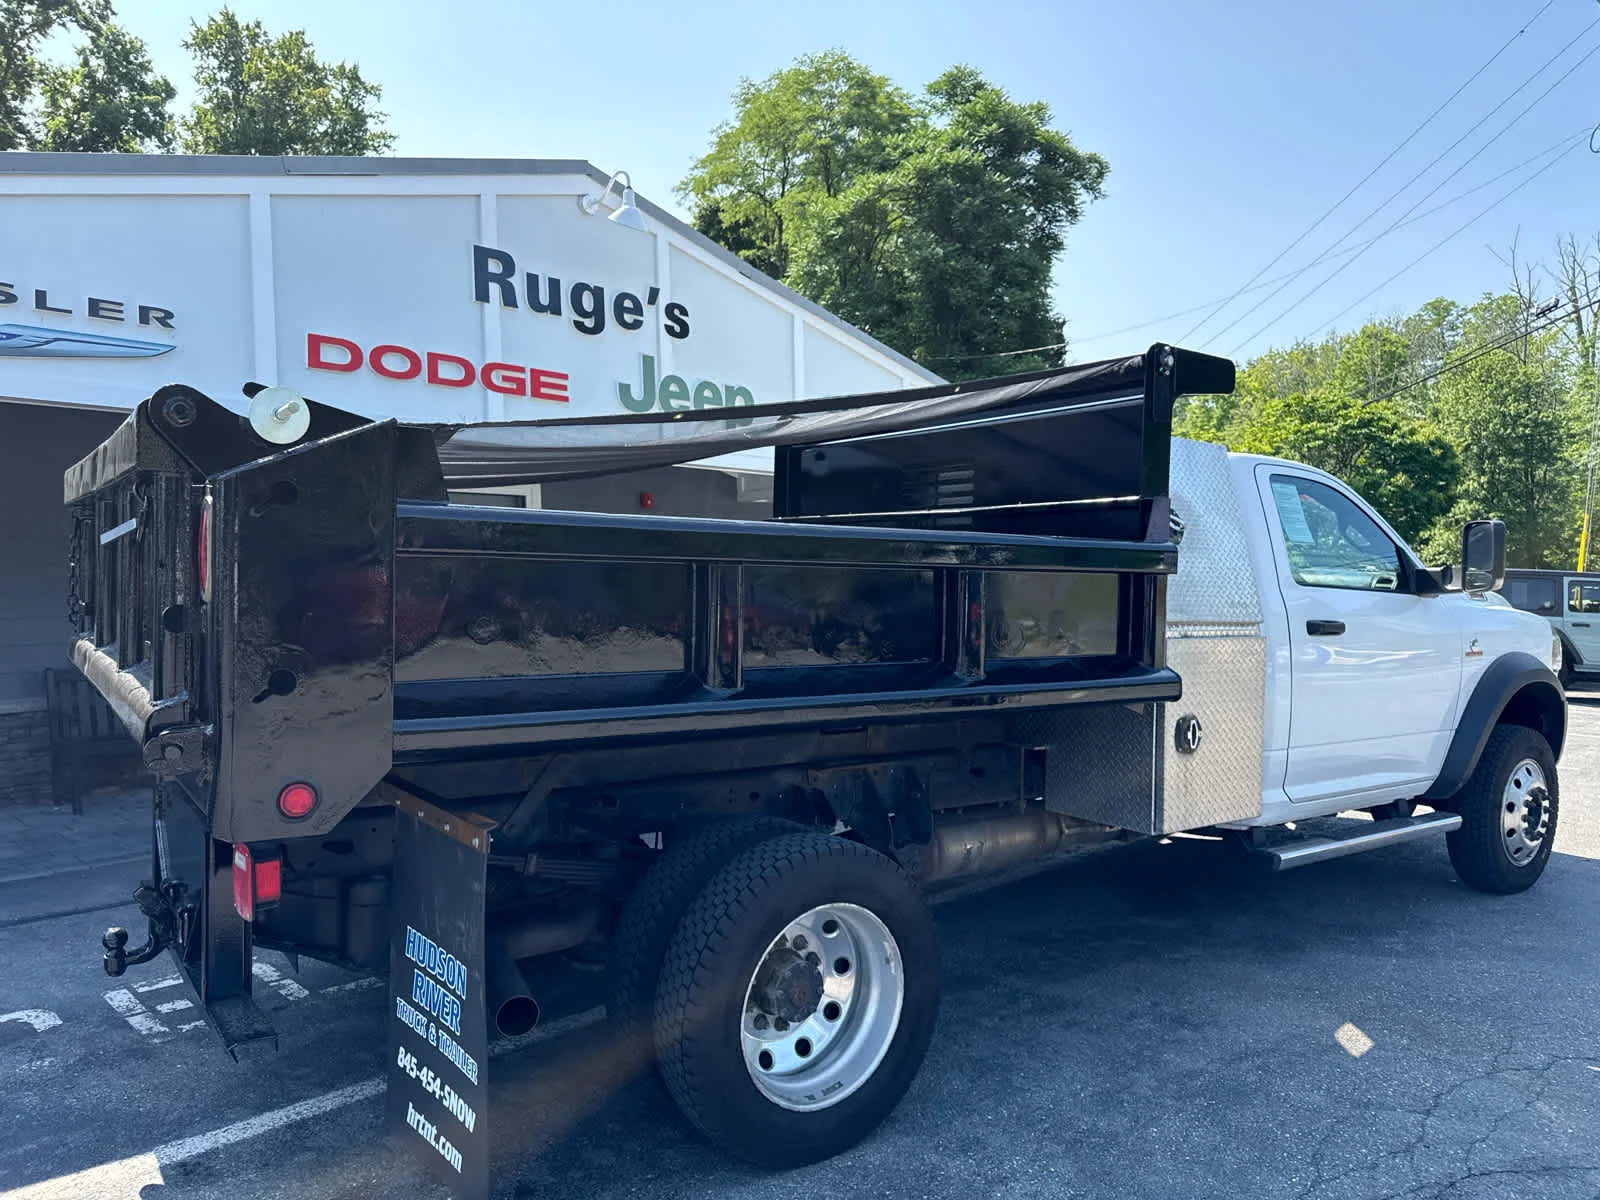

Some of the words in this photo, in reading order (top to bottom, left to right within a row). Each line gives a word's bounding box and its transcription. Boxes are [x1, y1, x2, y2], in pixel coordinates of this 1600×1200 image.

[473, 244, 691, 340] Ruge's
[306, 332, 569, 403] DODGE
[618, 353, 755, 430] Jeep
[405, 925, 467, 1000] HUDSON
[412, 968, 461, 1036] RIVER
[396, 996, 428, 1038] TRUCK
[428, 1022, 437, 1047] &
[438, 1029, 478, 1086] TRAILER
[397, 1046, 476, 1133] 845-454-SNOW
[406, 1101, 463, 1173] hrtnt.com
